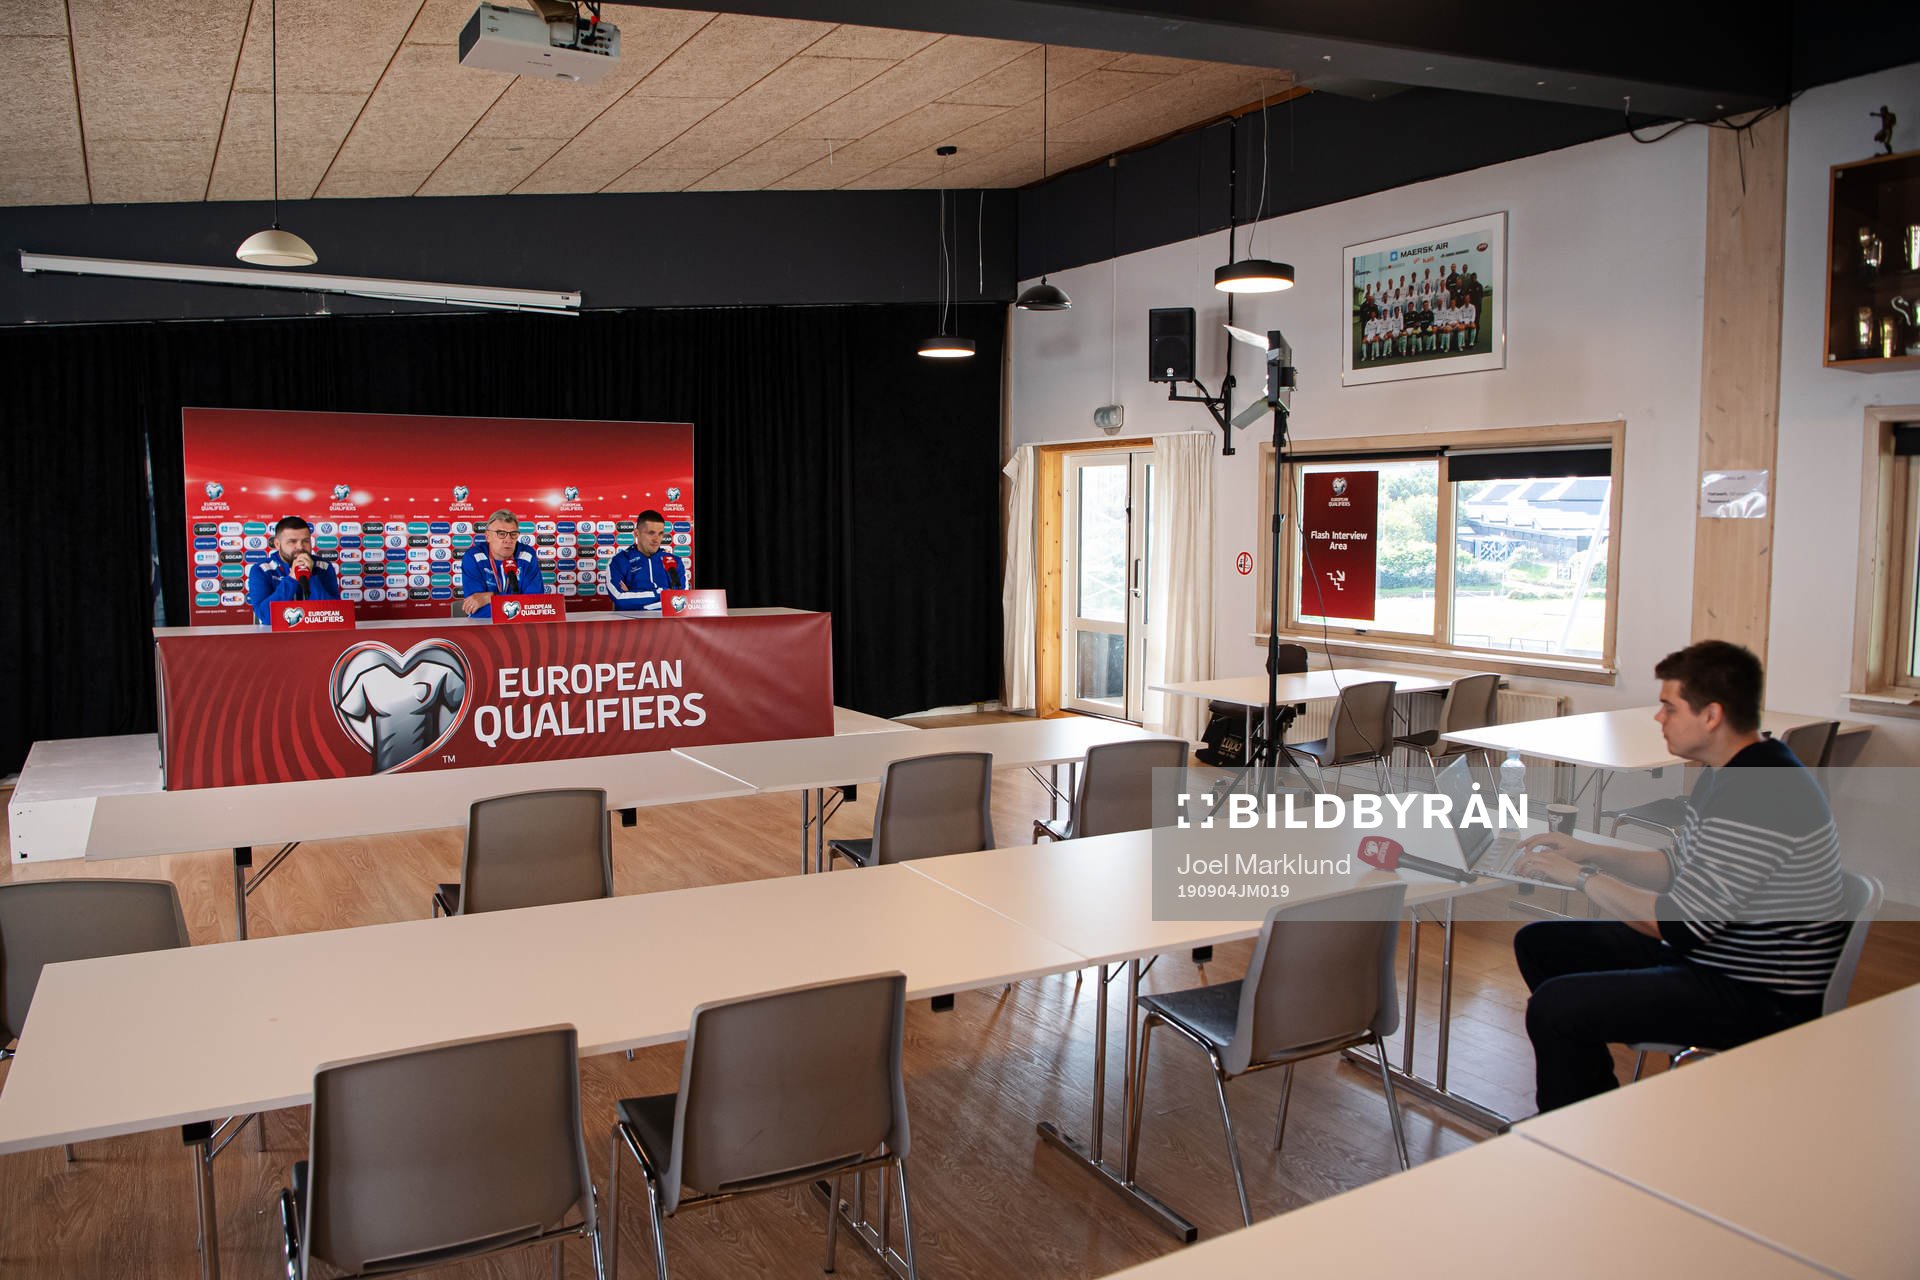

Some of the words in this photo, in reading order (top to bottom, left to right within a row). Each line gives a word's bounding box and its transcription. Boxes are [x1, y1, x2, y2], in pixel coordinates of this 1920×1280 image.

[1400, 245, 1433, 258] MAERSK
[1435, 242, 1448, 250] AIR
[1310, 531, 1330, 539] Flash
[1332, 531, 1368, 540] Interview
[1329, 542, 1348, 550] Area
[499, 660, 682, 698] EUROPEAN
[474, 693, 707, 748] QUALIFIERS
[442, 755, 456, 763] TM
